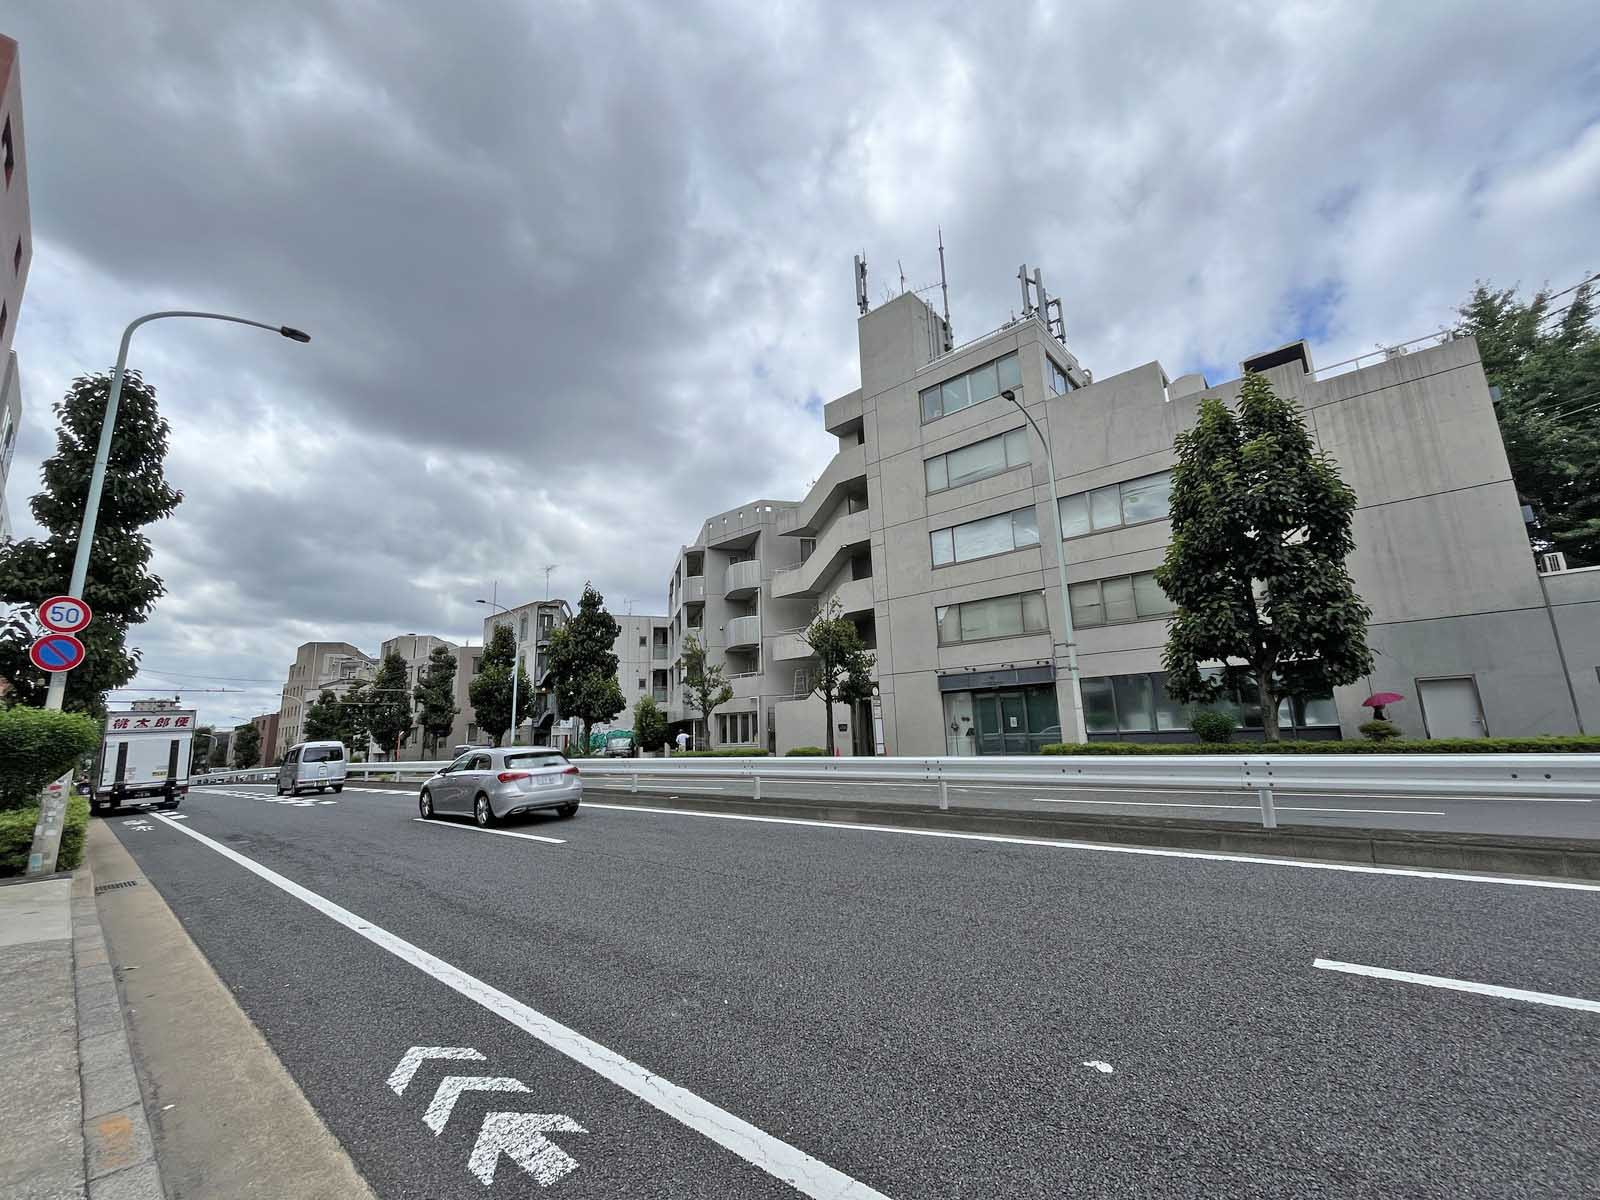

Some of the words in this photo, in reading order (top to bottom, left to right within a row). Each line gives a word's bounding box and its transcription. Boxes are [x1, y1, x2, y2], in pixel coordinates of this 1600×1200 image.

[50, 606, 79, 623] 50
[113, 716, 191, 729] 桃太郎便
